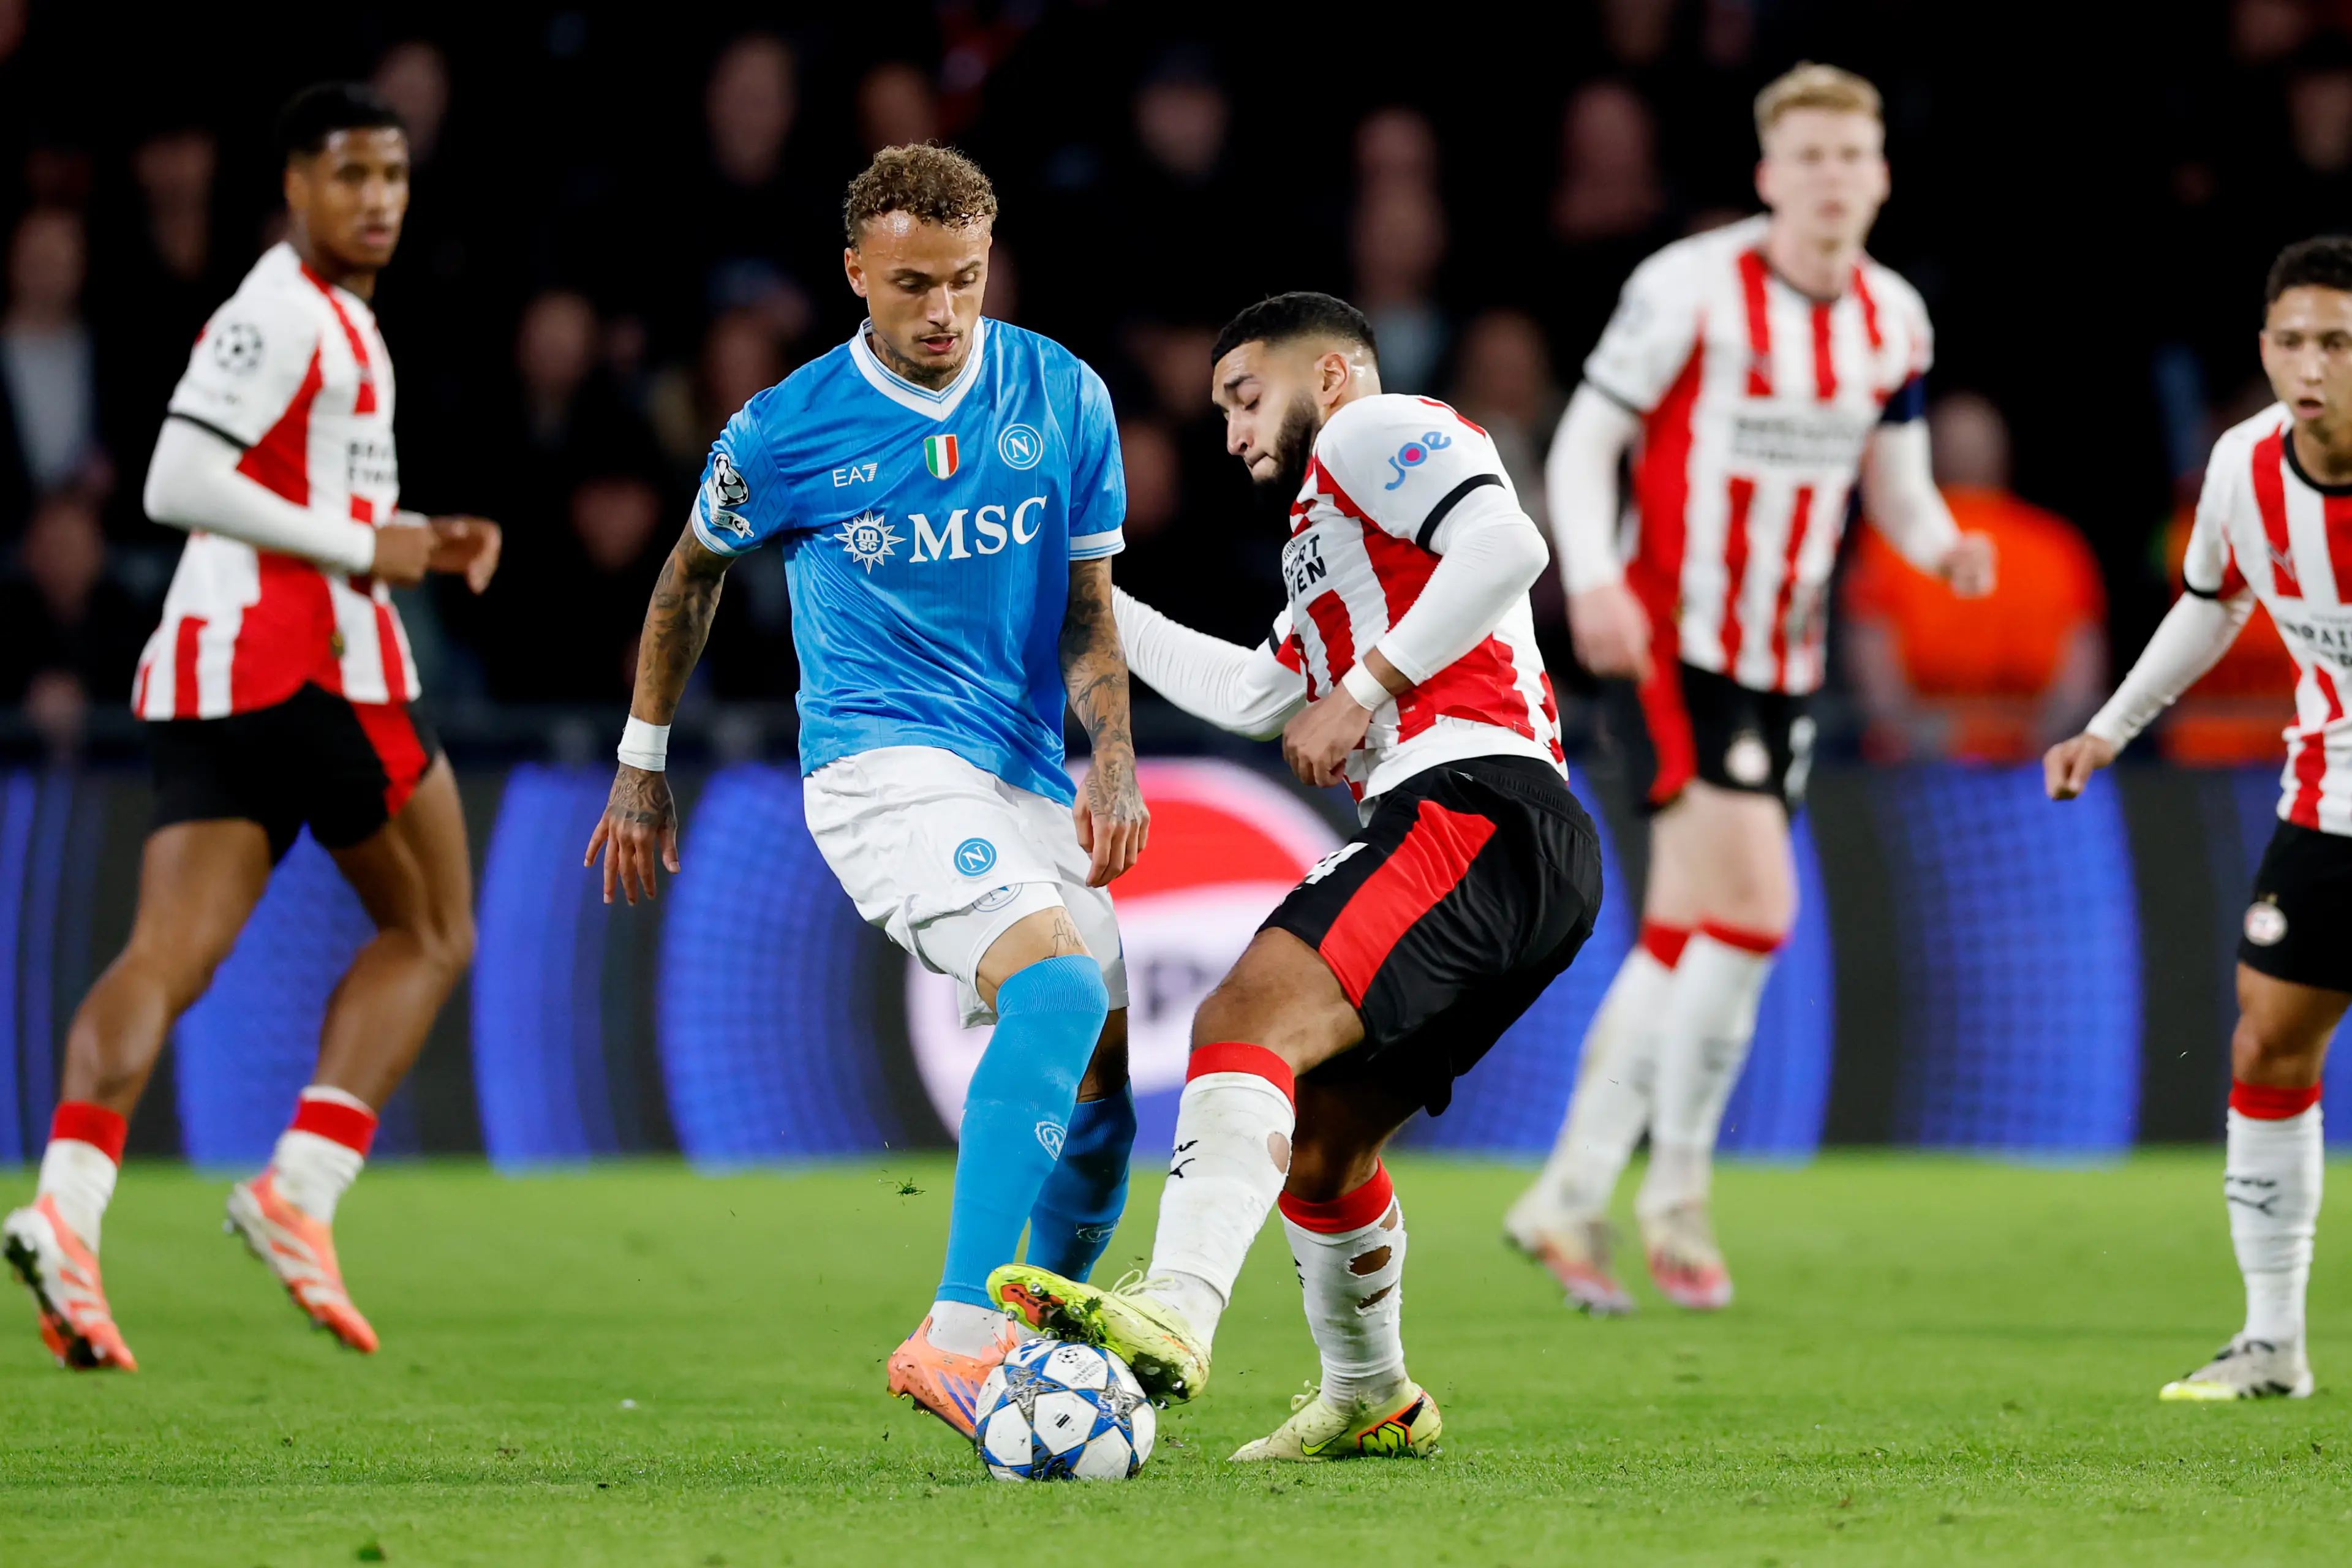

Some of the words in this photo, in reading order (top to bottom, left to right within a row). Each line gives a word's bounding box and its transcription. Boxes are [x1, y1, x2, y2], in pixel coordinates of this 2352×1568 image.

[1009, 435, 1030, 458] N
[1384, 431, 1452, 491] joe
[832, 462, 878, 488] EA7
[908, 495, 1047, 564] MSC
[962, 845, 987, 870] N
